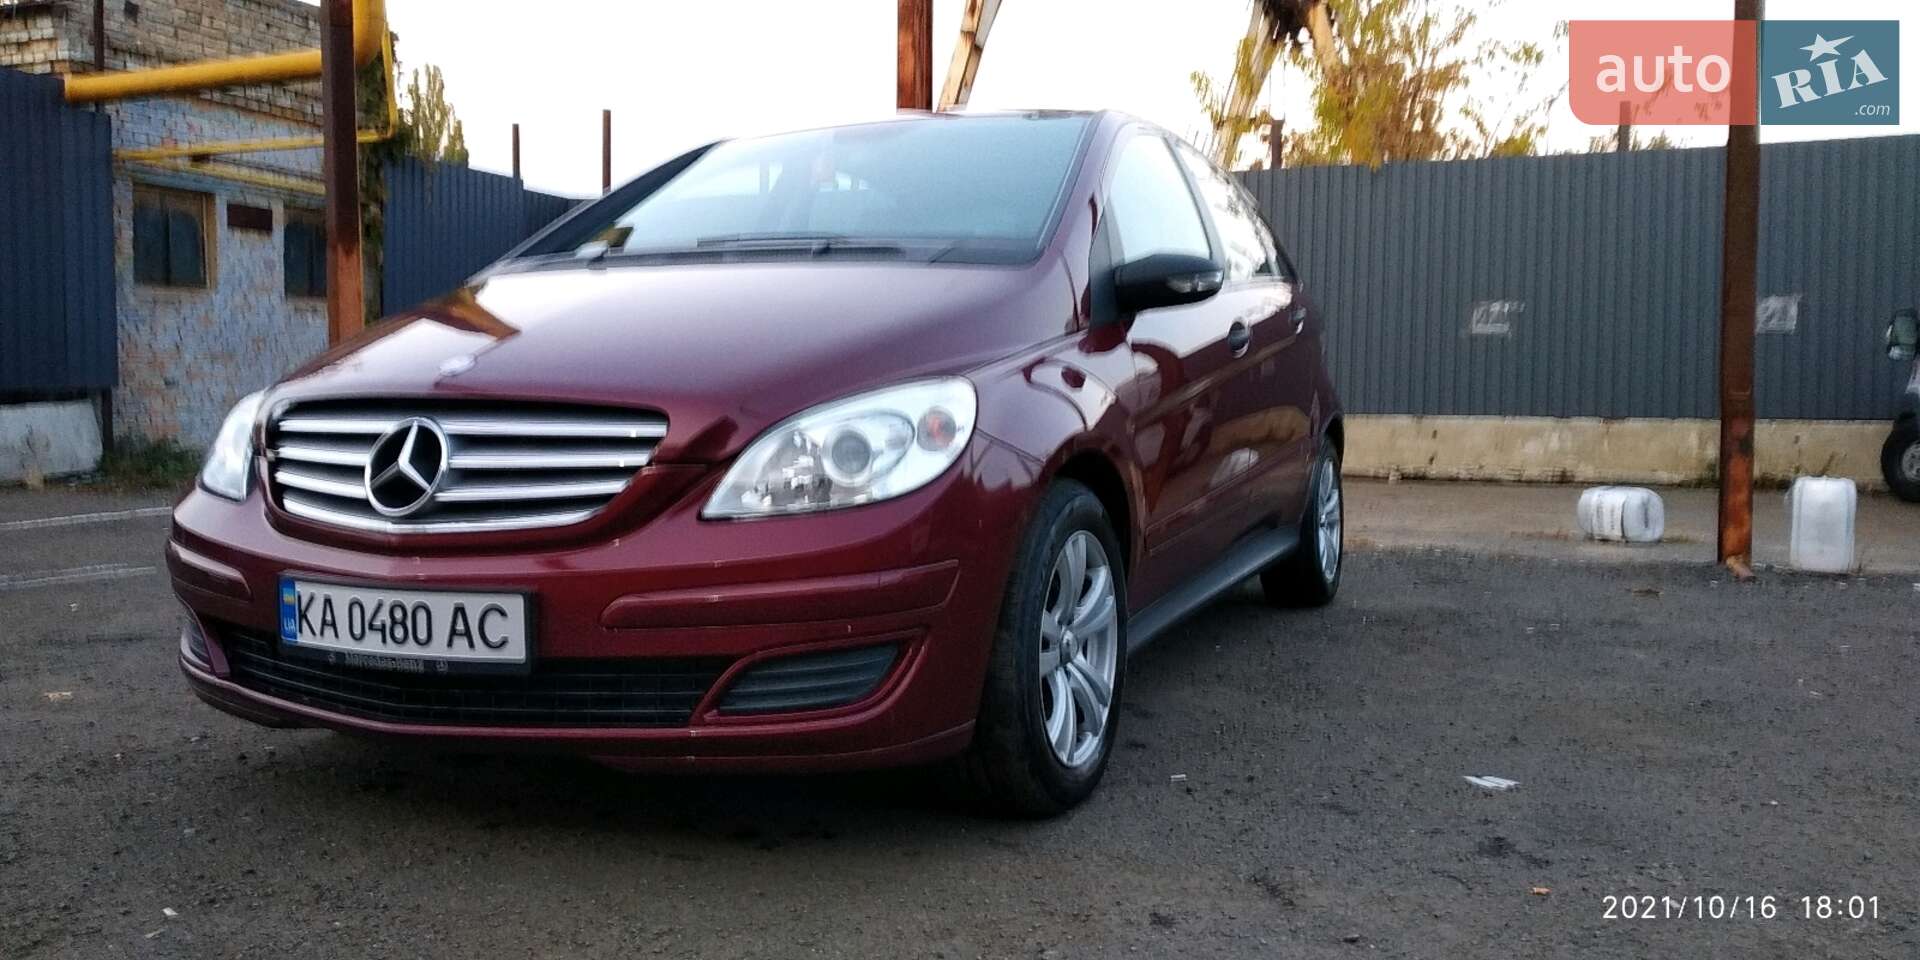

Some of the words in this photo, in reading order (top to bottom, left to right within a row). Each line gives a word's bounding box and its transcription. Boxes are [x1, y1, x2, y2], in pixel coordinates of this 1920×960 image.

[298, 591, 339, 639] KA
[348, 597, 433, 646] 0480
[446, 602, 509, 650] AC
